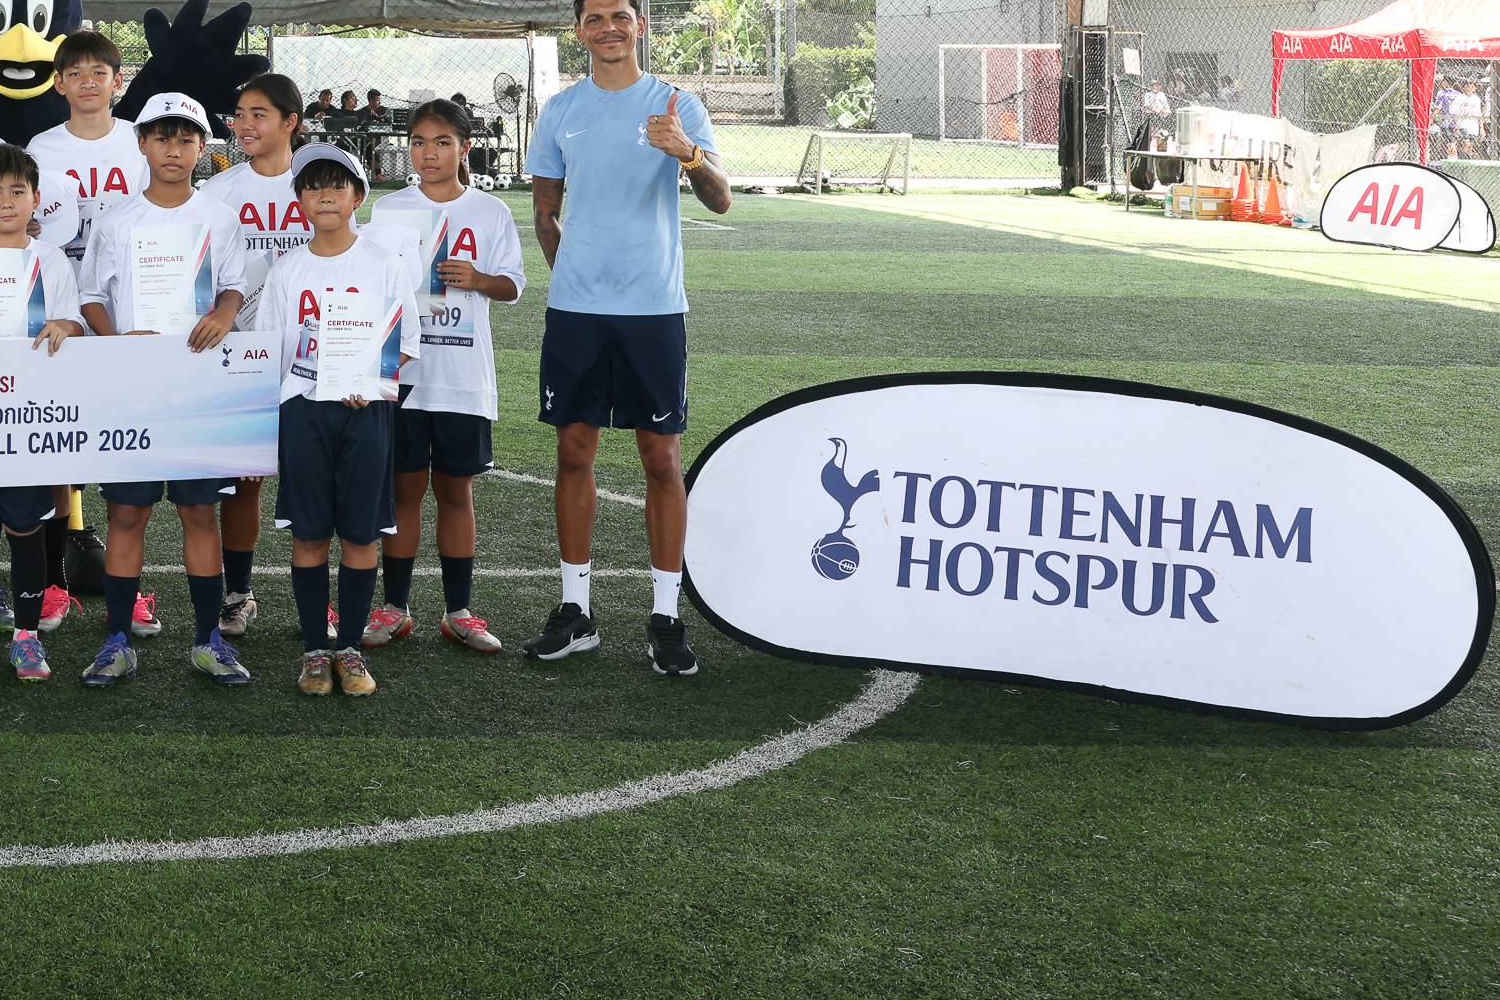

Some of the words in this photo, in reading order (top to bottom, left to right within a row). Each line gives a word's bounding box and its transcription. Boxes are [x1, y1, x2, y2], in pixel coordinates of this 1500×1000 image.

[1281, 36, 1304, 54] AIA
[1329, 34, 1353, 53] AIA
[1380, 35, 1408, 53] AIA
[180, 101, 199, 116] AIA
[43, 201, 62, 217] AIA
[1347, 182, 1424, 230] AIA
[239, 201, 310, 232] AIA
[139, 255, 184, 264] CERTIFICATE
[327, 320, 373, 328] CERTIFICATE
[243, 349, 269, 360] AIA
[28, 431, 88, 454] CAMP
[99, 428, 151, 451] 2026
[892, 470, 1314, 564] TOTTENHAM
[895, 536, 1221, 624] HOTSPUR
